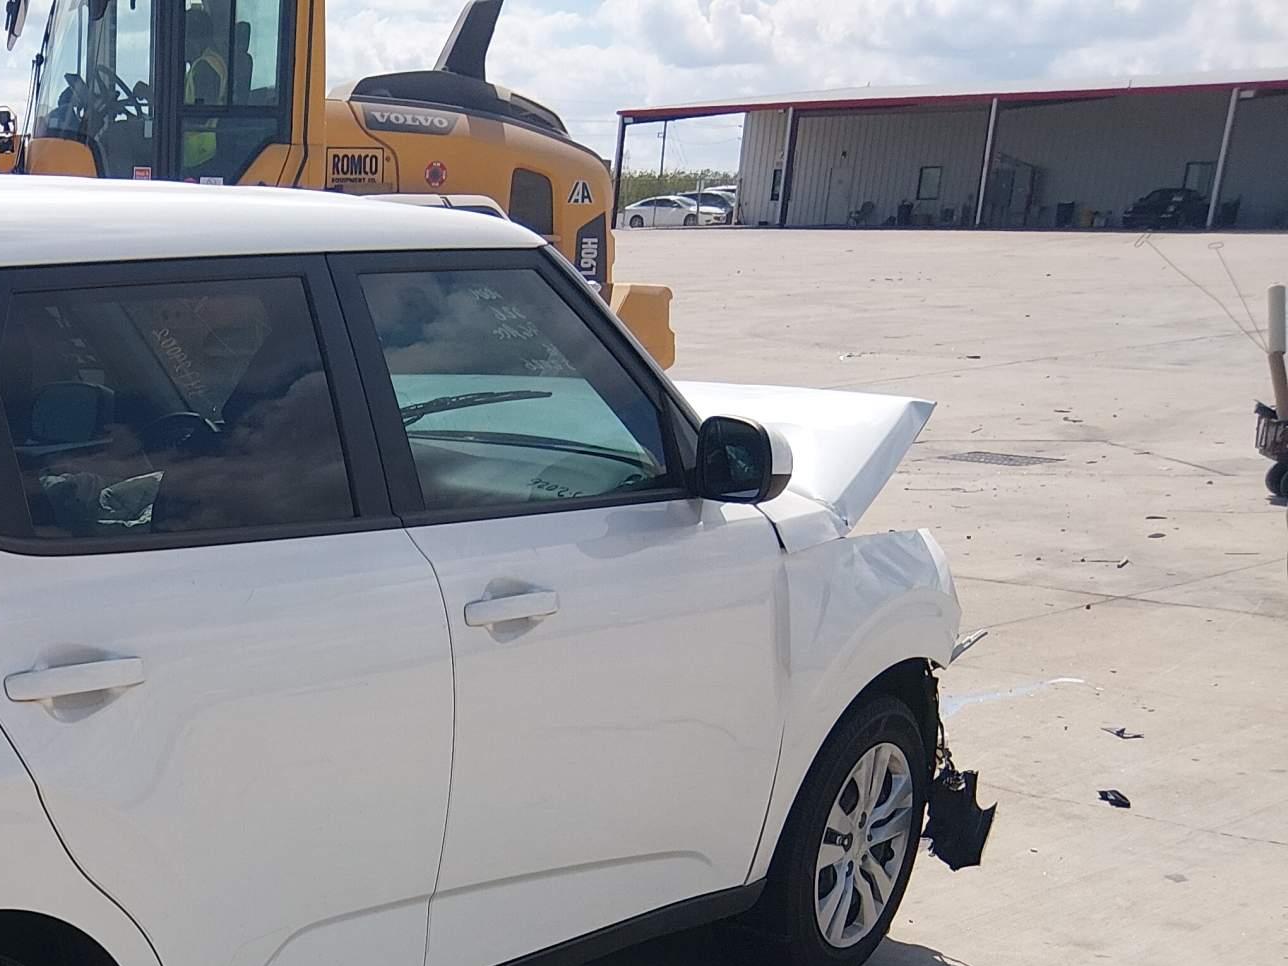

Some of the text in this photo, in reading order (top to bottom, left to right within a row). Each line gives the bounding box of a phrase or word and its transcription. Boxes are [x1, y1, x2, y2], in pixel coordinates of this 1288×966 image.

[370, 111, 448, 128] VOLVO
[332, 153, 378, 176] ROMCO
[580, 237, 599, 276] L90H
